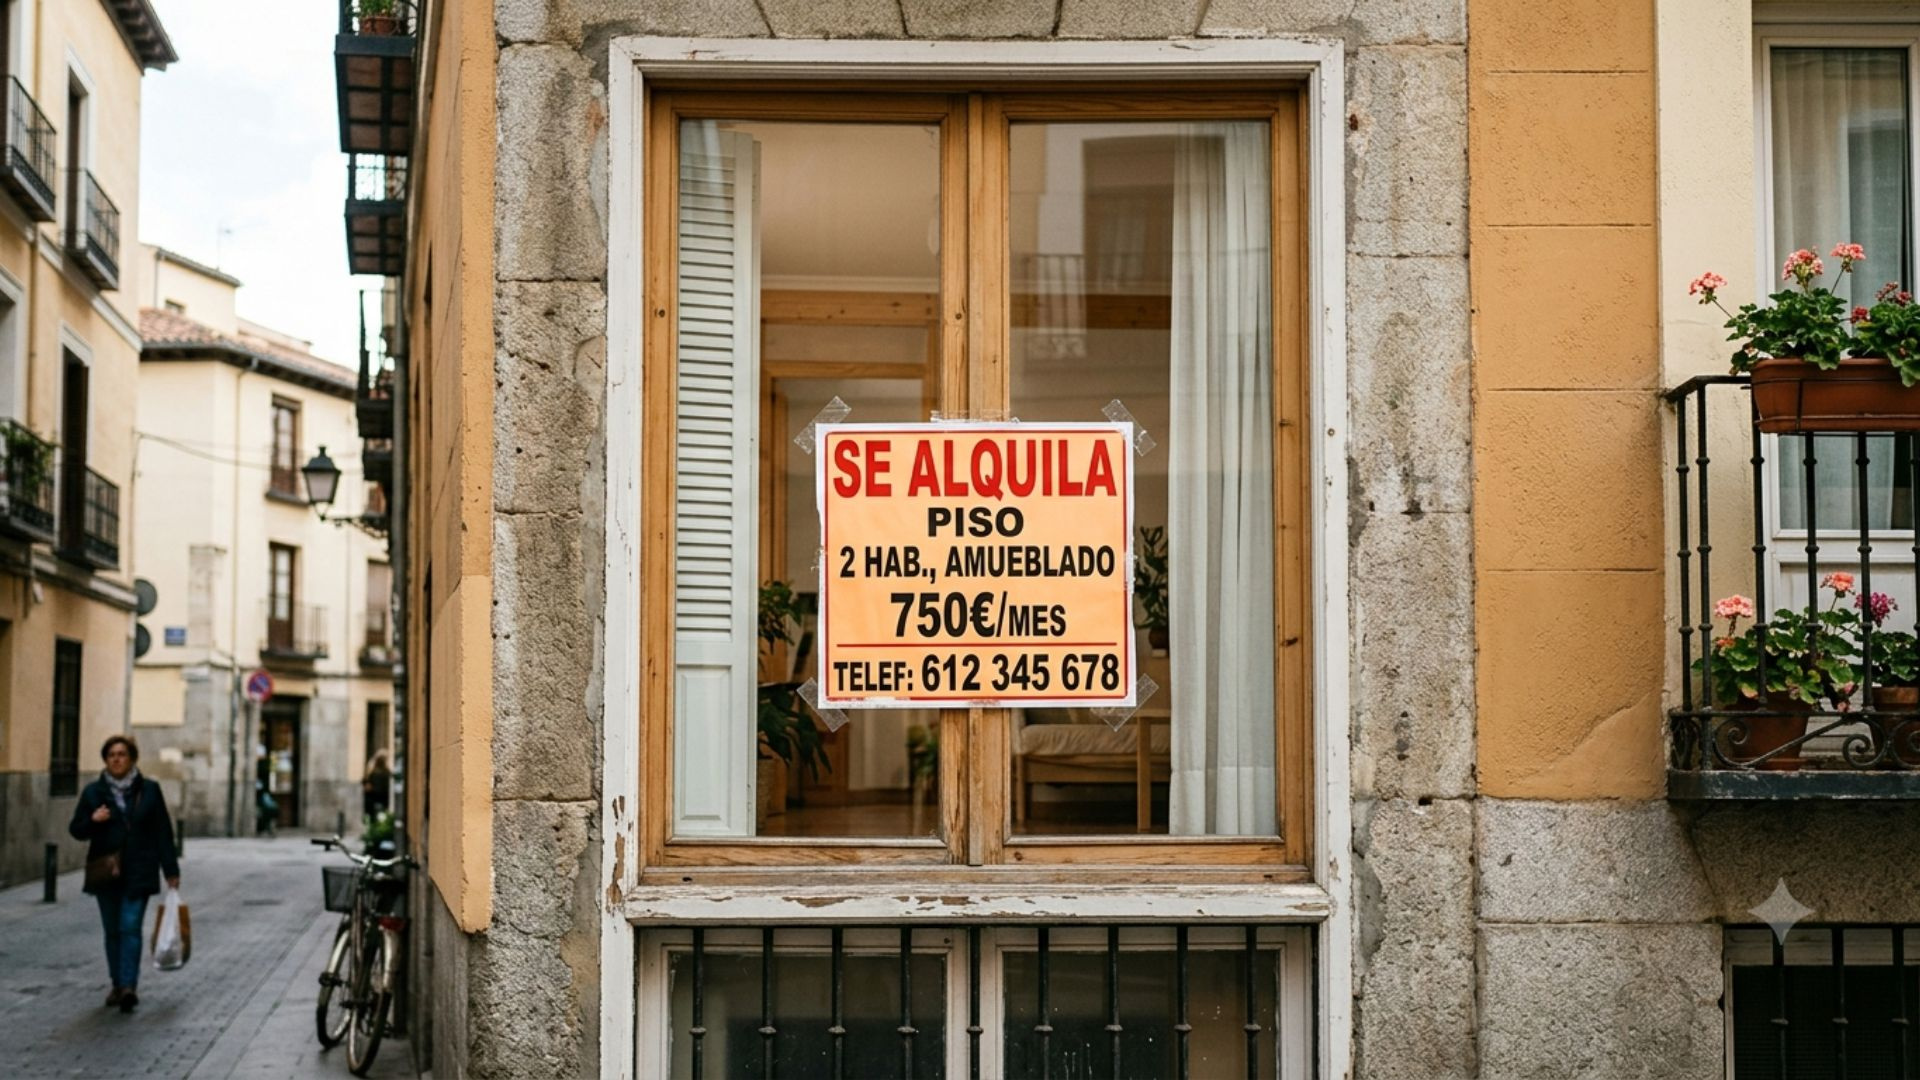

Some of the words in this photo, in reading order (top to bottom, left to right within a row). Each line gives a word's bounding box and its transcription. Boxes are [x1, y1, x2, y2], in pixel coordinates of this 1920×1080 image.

[834, 439, 892, 498] SE
[908, 439, 1117, 500] ALQUILA
[927, 507, 1024, 537] PISO
[840, 546, 856, 578] 2
[865, 546, 936, 584] HAB.,
[945, 545, 1115, 577] AMUEBLADO
[891, 591, 1067, 638] 750€/MES
[834, 662, 913, 692] TELEF:
[922, 654, 981, 692] 612
[992, 654, 1051, 692] 345
[1062, 654, 1120, 691] 678
